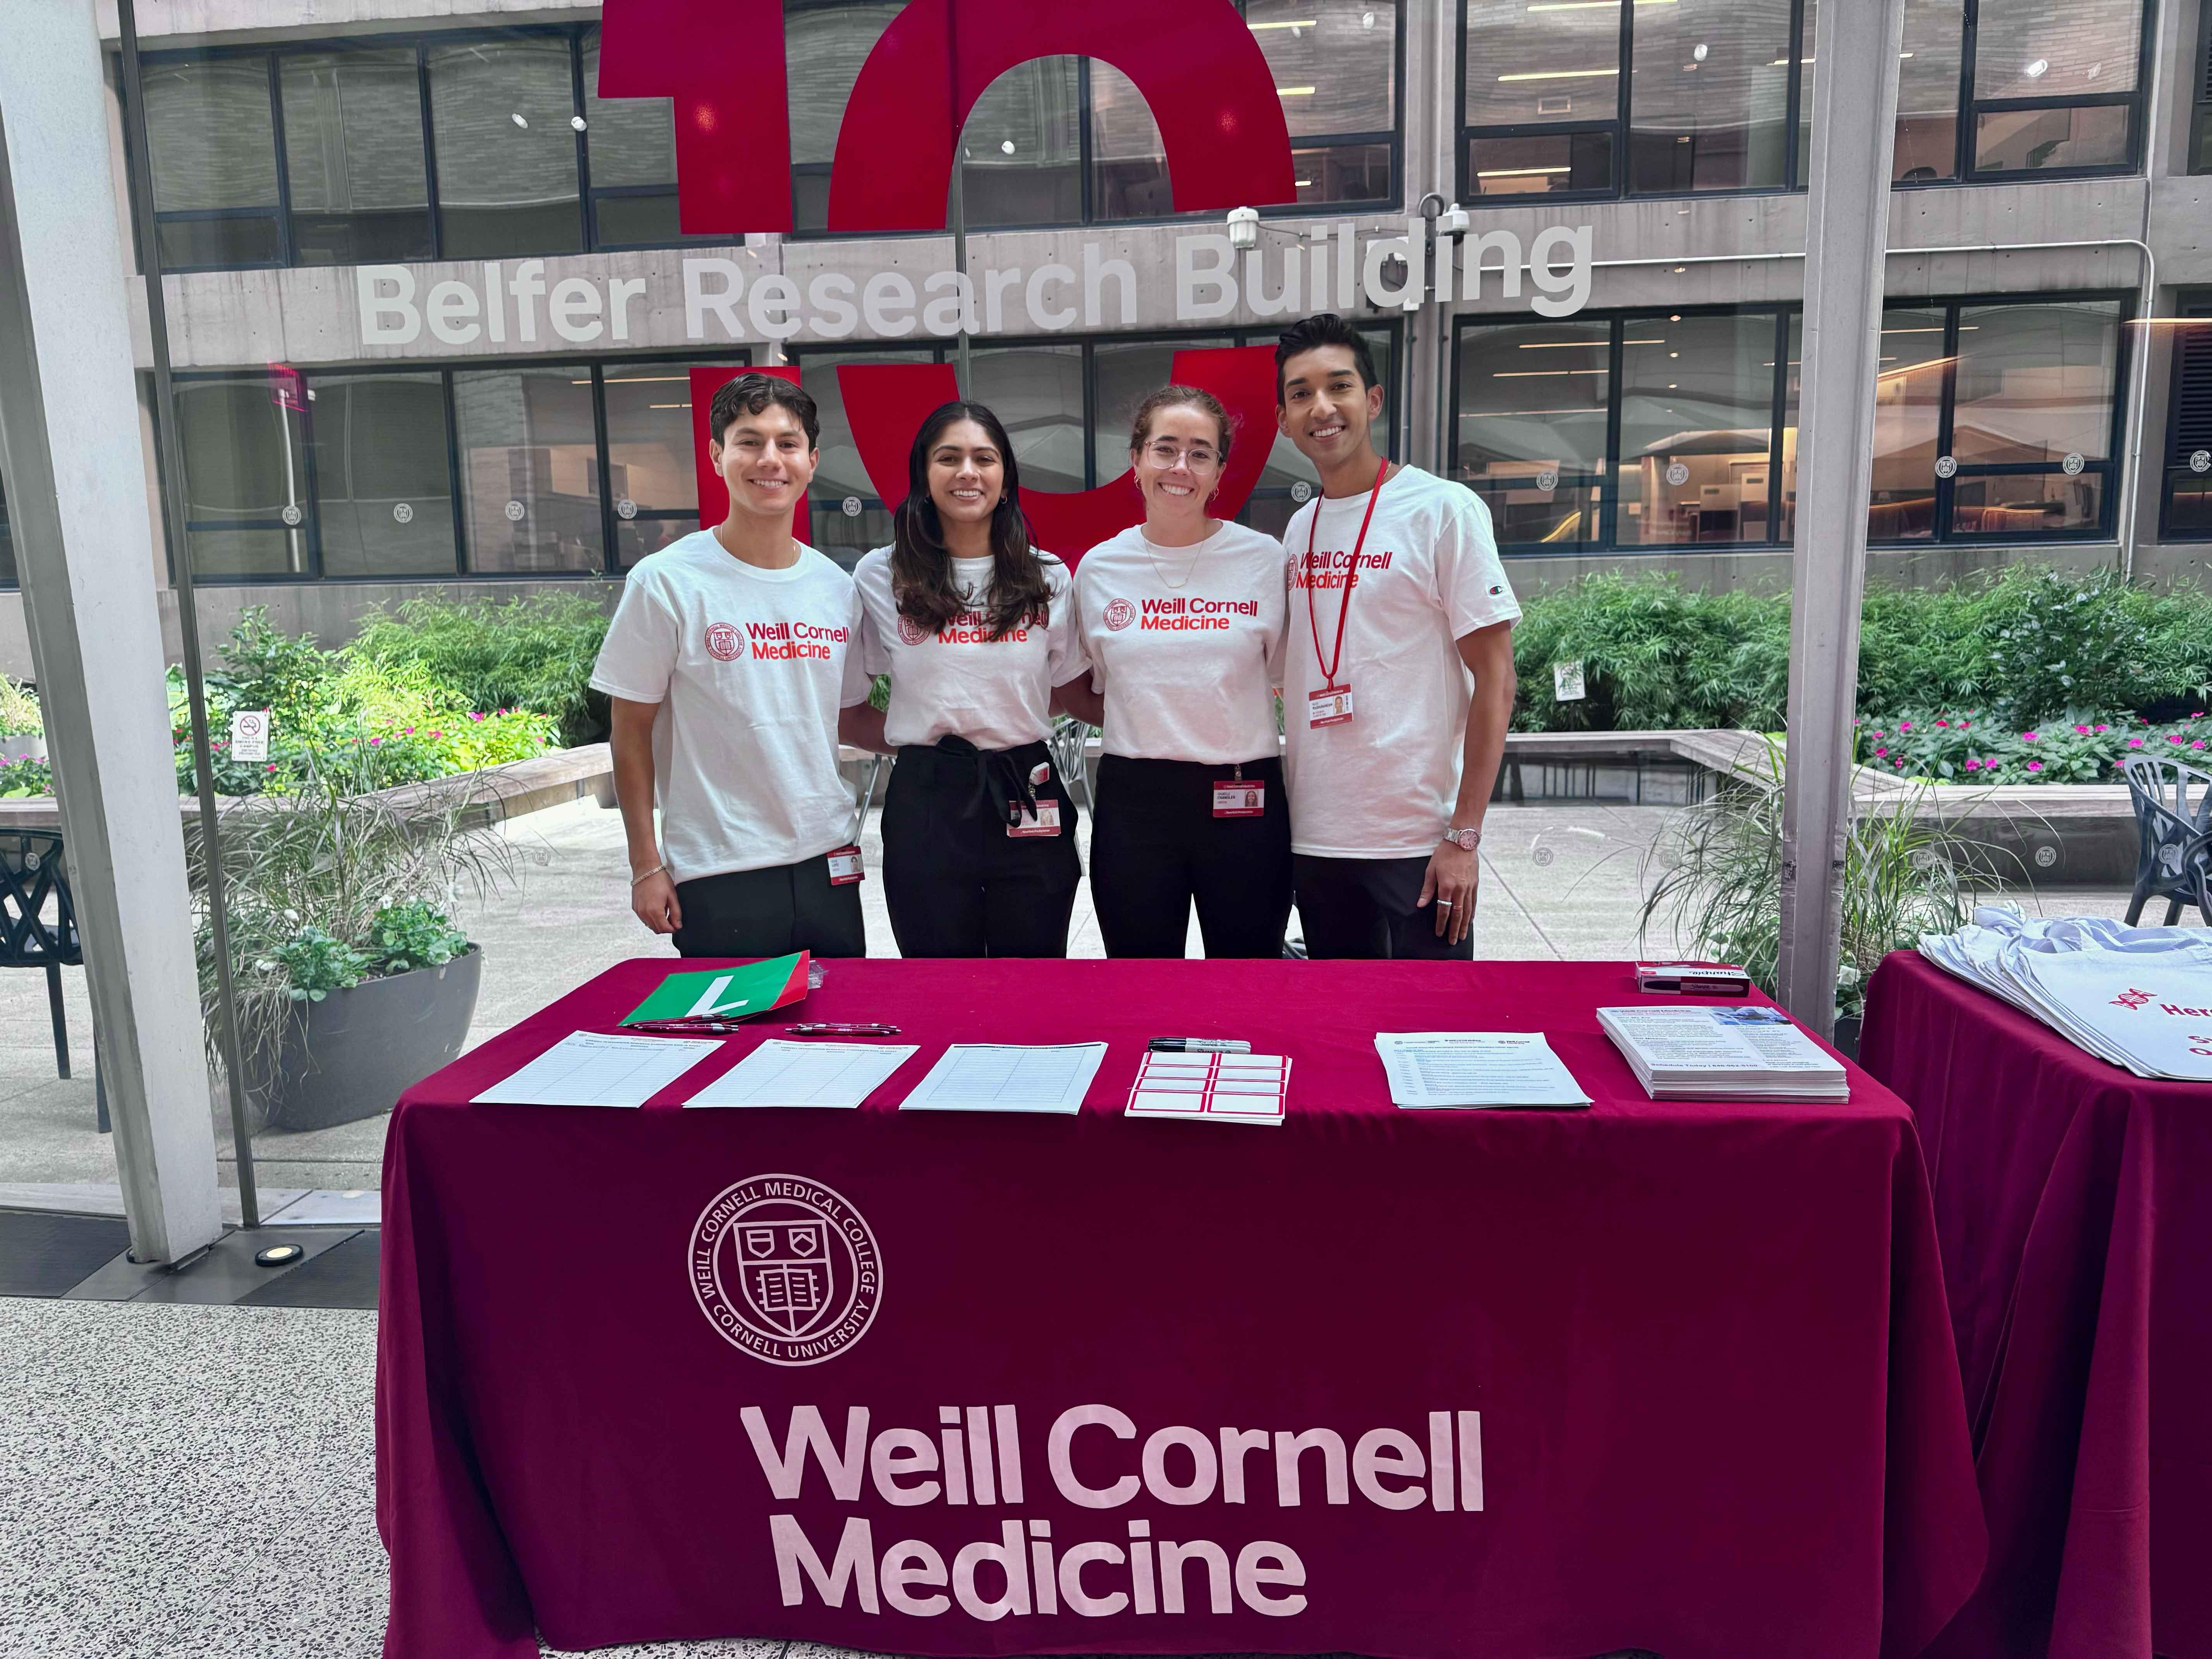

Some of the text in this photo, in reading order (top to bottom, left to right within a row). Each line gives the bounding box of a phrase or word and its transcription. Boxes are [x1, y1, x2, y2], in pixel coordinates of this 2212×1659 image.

[356, 217, 1593, 345] Belfer Research Building
[1300, 551, 1331, 569] Weill
[1142, 598, 1258, 617] Weill Cornell
[745, 622, 849, 643] Weill Cornell
[1141, 615, 1230, 630] Medicine
[752, 641, 831, 660] Medicine
[2159, 1004, 2212, 1016] Her
[696, 1182, 875, 1300] WEILL CORNELL MEDICAL COLLEGE
[713, 1299, 869, 1358] CORNELL UNIVERSITY
[740, 1404, 1484, 1511] Weill Cornell
[769, 1514, 1308, 1621] Medicine
